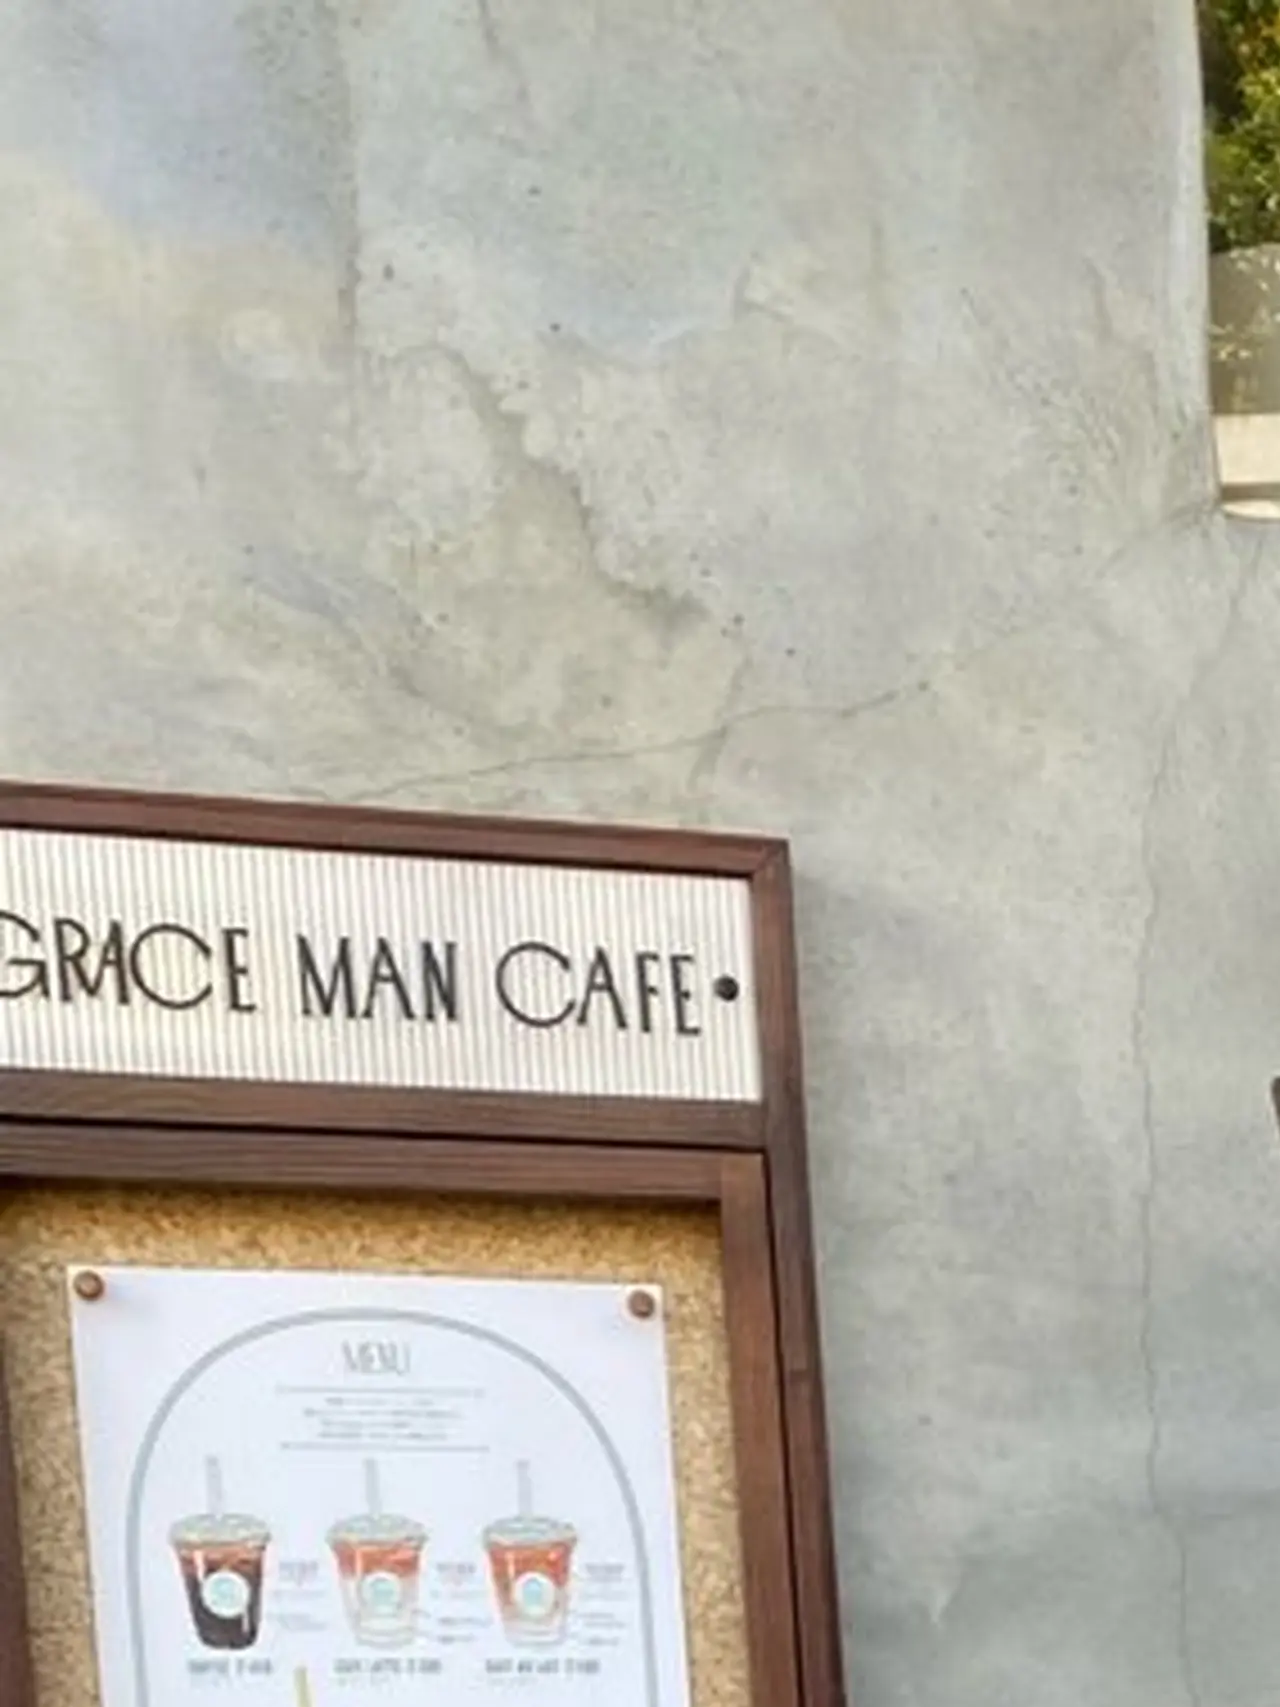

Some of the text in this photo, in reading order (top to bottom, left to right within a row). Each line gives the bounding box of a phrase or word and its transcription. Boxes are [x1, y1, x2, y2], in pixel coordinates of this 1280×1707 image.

[0, 910, 701, 1036] GRACE MAN CAFE
